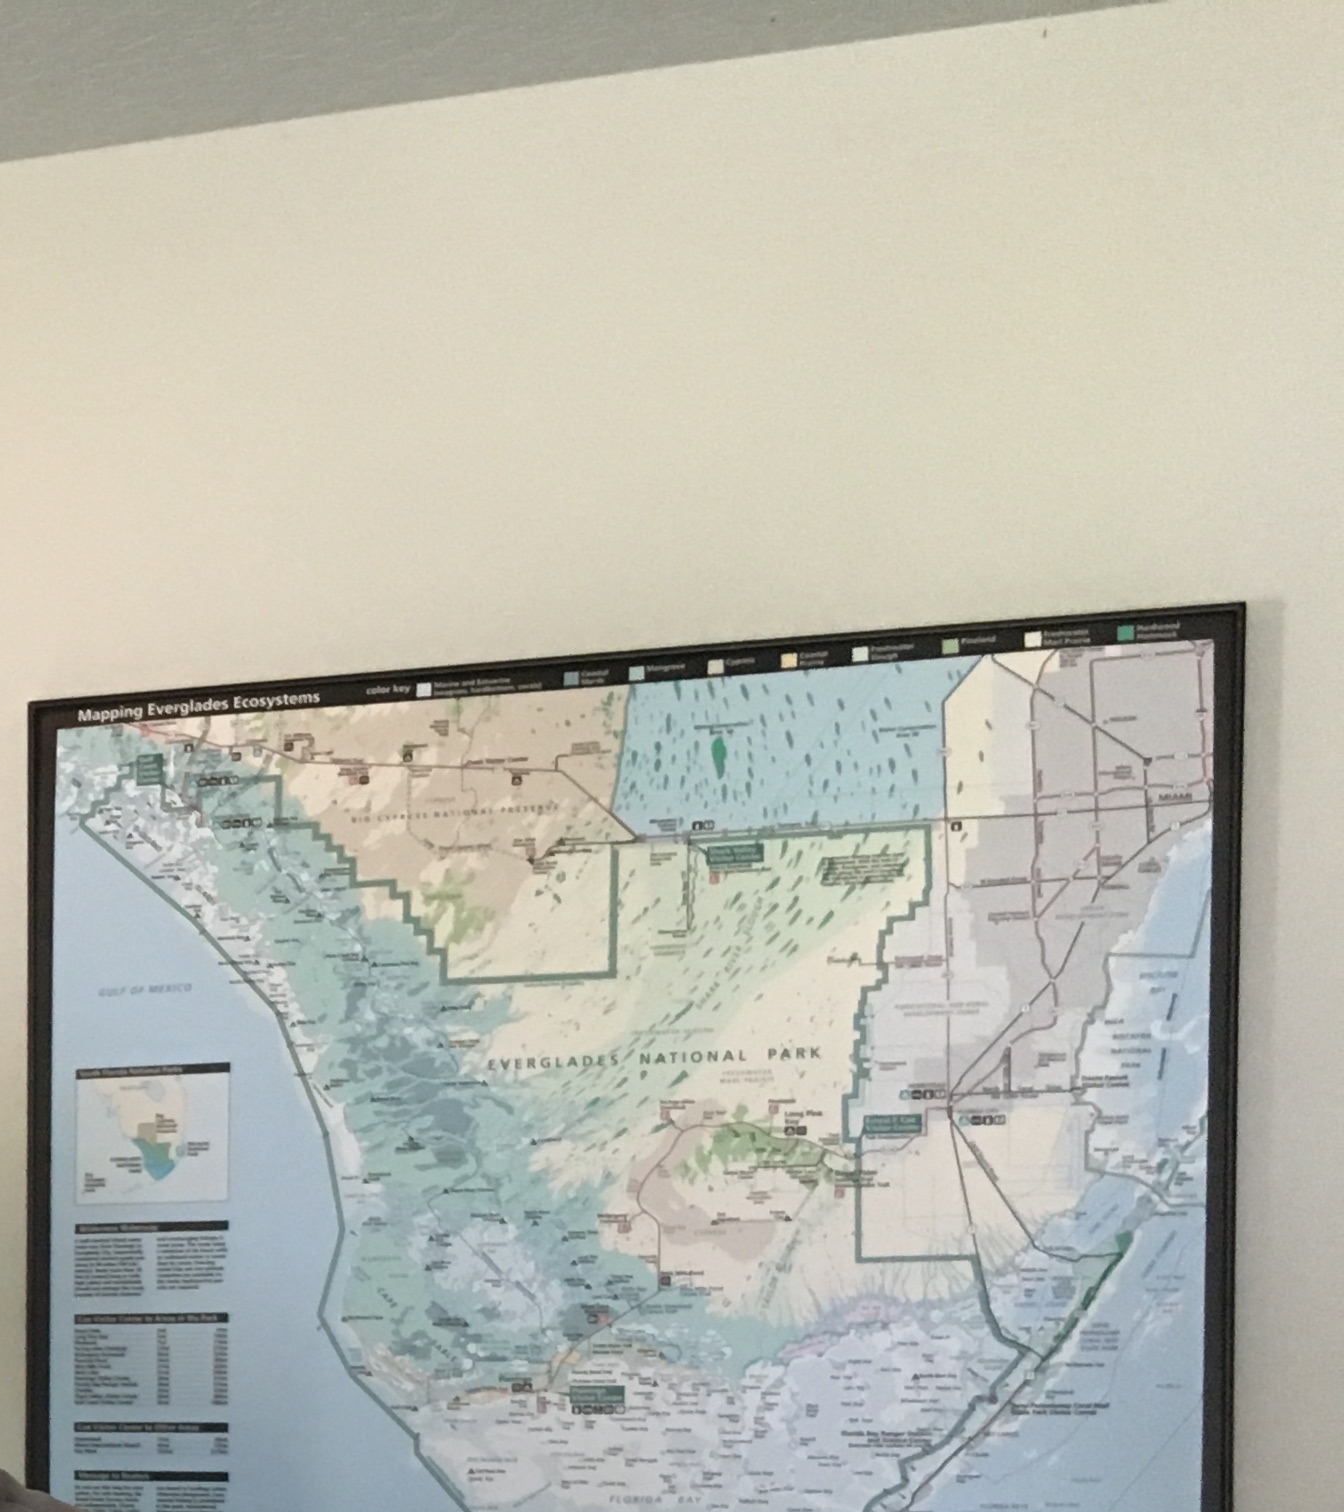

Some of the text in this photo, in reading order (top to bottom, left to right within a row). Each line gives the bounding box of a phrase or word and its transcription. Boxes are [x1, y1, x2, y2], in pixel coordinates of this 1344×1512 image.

[366, 683, 412, 697] color key
[78, 690, 321, 727] Mapping Everglades Ecosystems
[487, 1045, 822, 1072] EVERGLADES NATIONAL PARK
